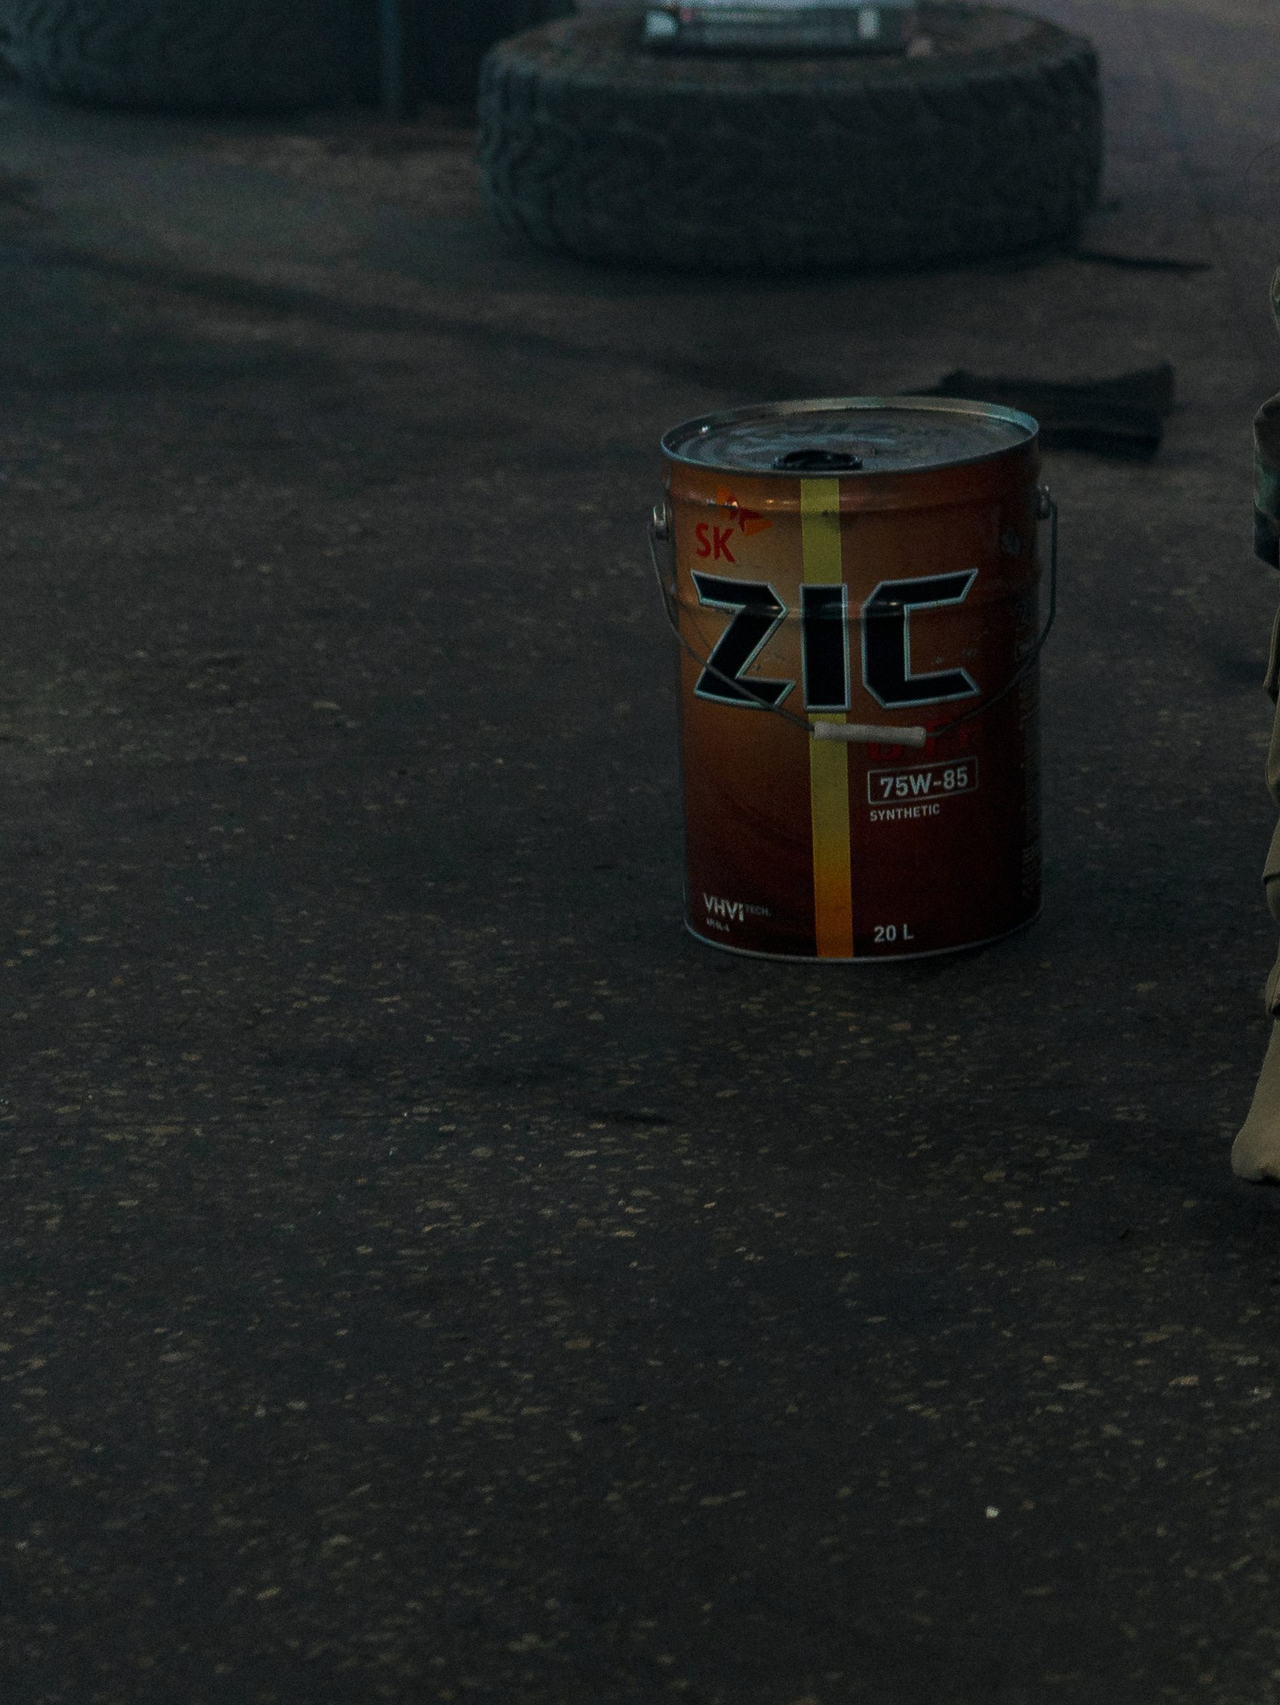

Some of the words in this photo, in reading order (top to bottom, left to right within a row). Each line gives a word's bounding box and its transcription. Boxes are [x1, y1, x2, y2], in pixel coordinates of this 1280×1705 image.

[695, 523, 736, 563] SK
[690, 568, 980, 712] ZIC
[880, 766, 969, 799] 75W-85
[869, 803, 941, 822] SYNTHETIC
[873, 924, 897, 943] 20
[903, 923, 914, 941] L
